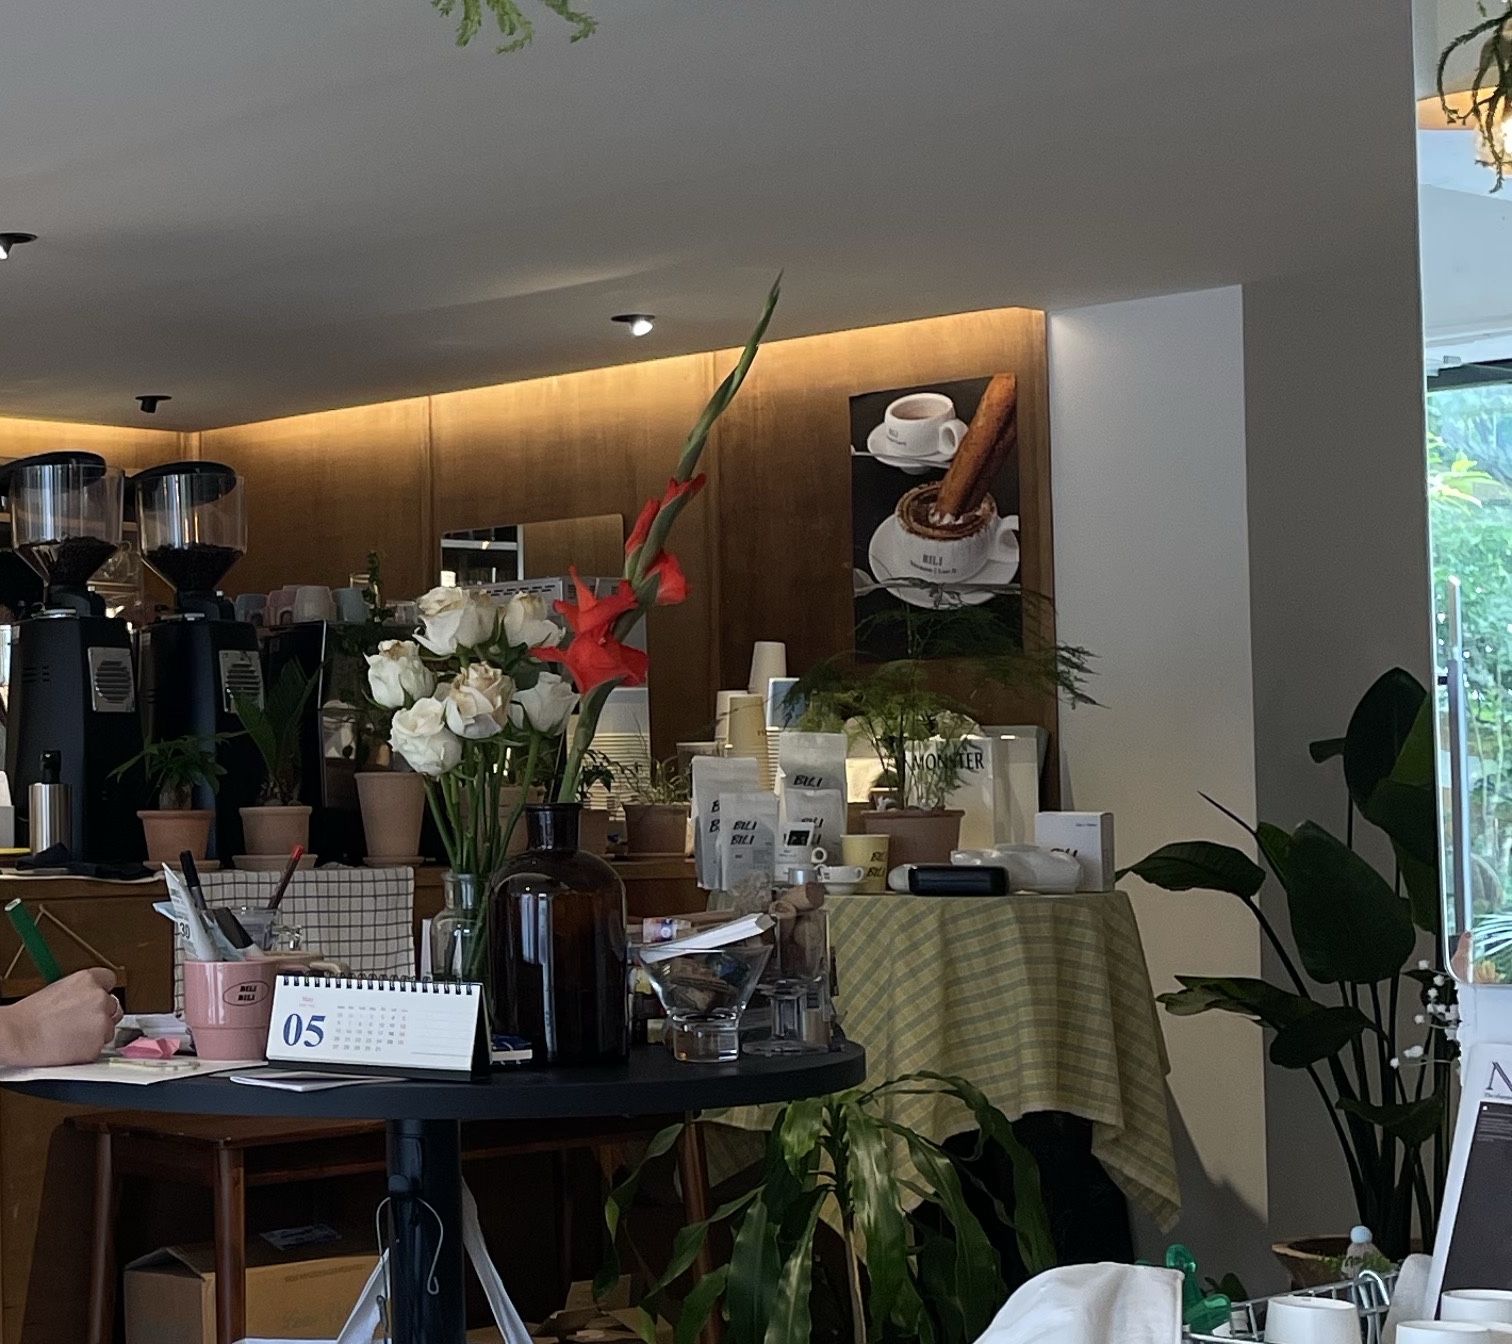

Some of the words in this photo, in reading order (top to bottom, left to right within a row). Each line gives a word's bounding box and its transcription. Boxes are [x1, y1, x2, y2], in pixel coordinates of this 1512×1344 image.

[793, 774, 823, 788] BILI
[733, 821, 758, 831] BILI
[730, 834, 755, 845] BILI
[282, 1012, 326, 1048] 05
